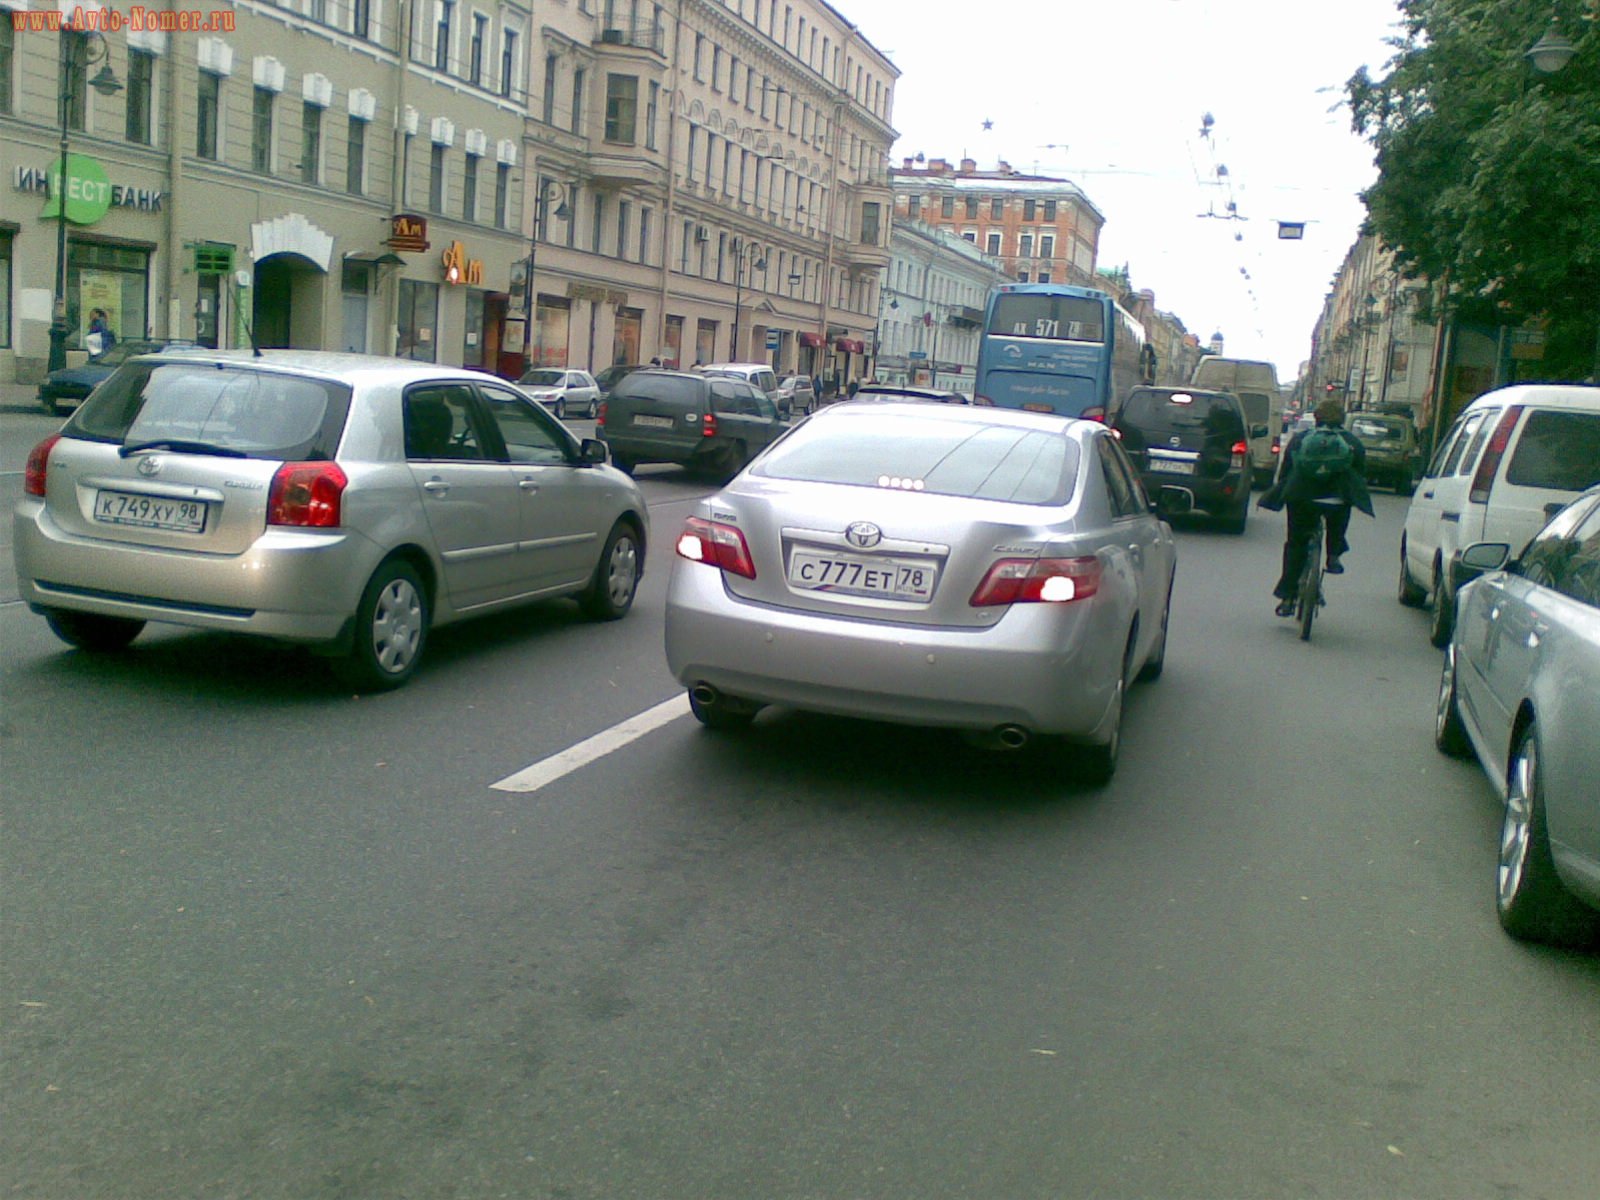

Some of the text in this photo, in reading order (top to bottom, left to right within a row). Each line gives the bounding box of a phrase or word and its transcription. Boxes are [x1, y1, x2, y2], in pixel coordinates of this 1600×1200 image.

[1035, 318, 1059, 337] 571
[180, 503, 198, 519] 98
[800, 560, 923, 589] C777ET 78
